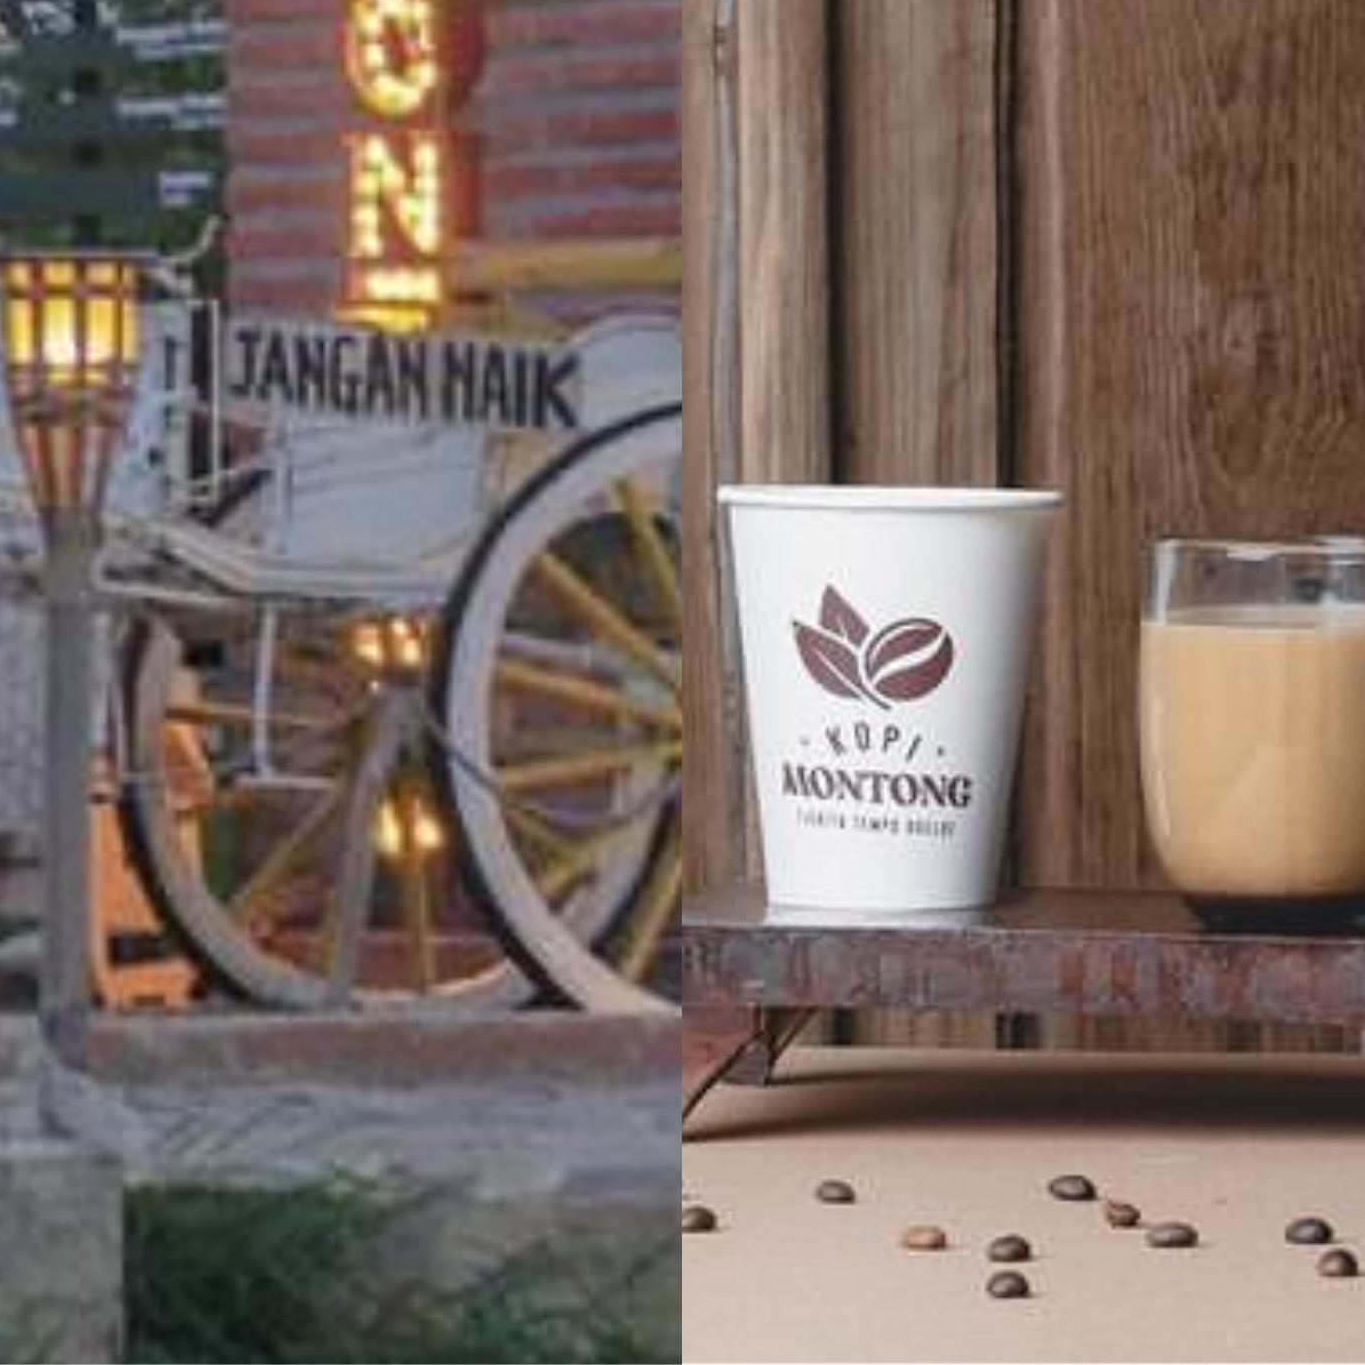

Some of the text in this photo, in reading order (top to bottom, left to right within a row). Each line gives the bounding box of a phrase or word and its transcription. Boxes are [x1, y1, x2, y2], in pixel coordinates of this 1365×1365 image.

[230, 330, 428, 418] JANGAN
[825, 721, 923, 763] KOPI
[782, 761, 972, 809] MONTONG
